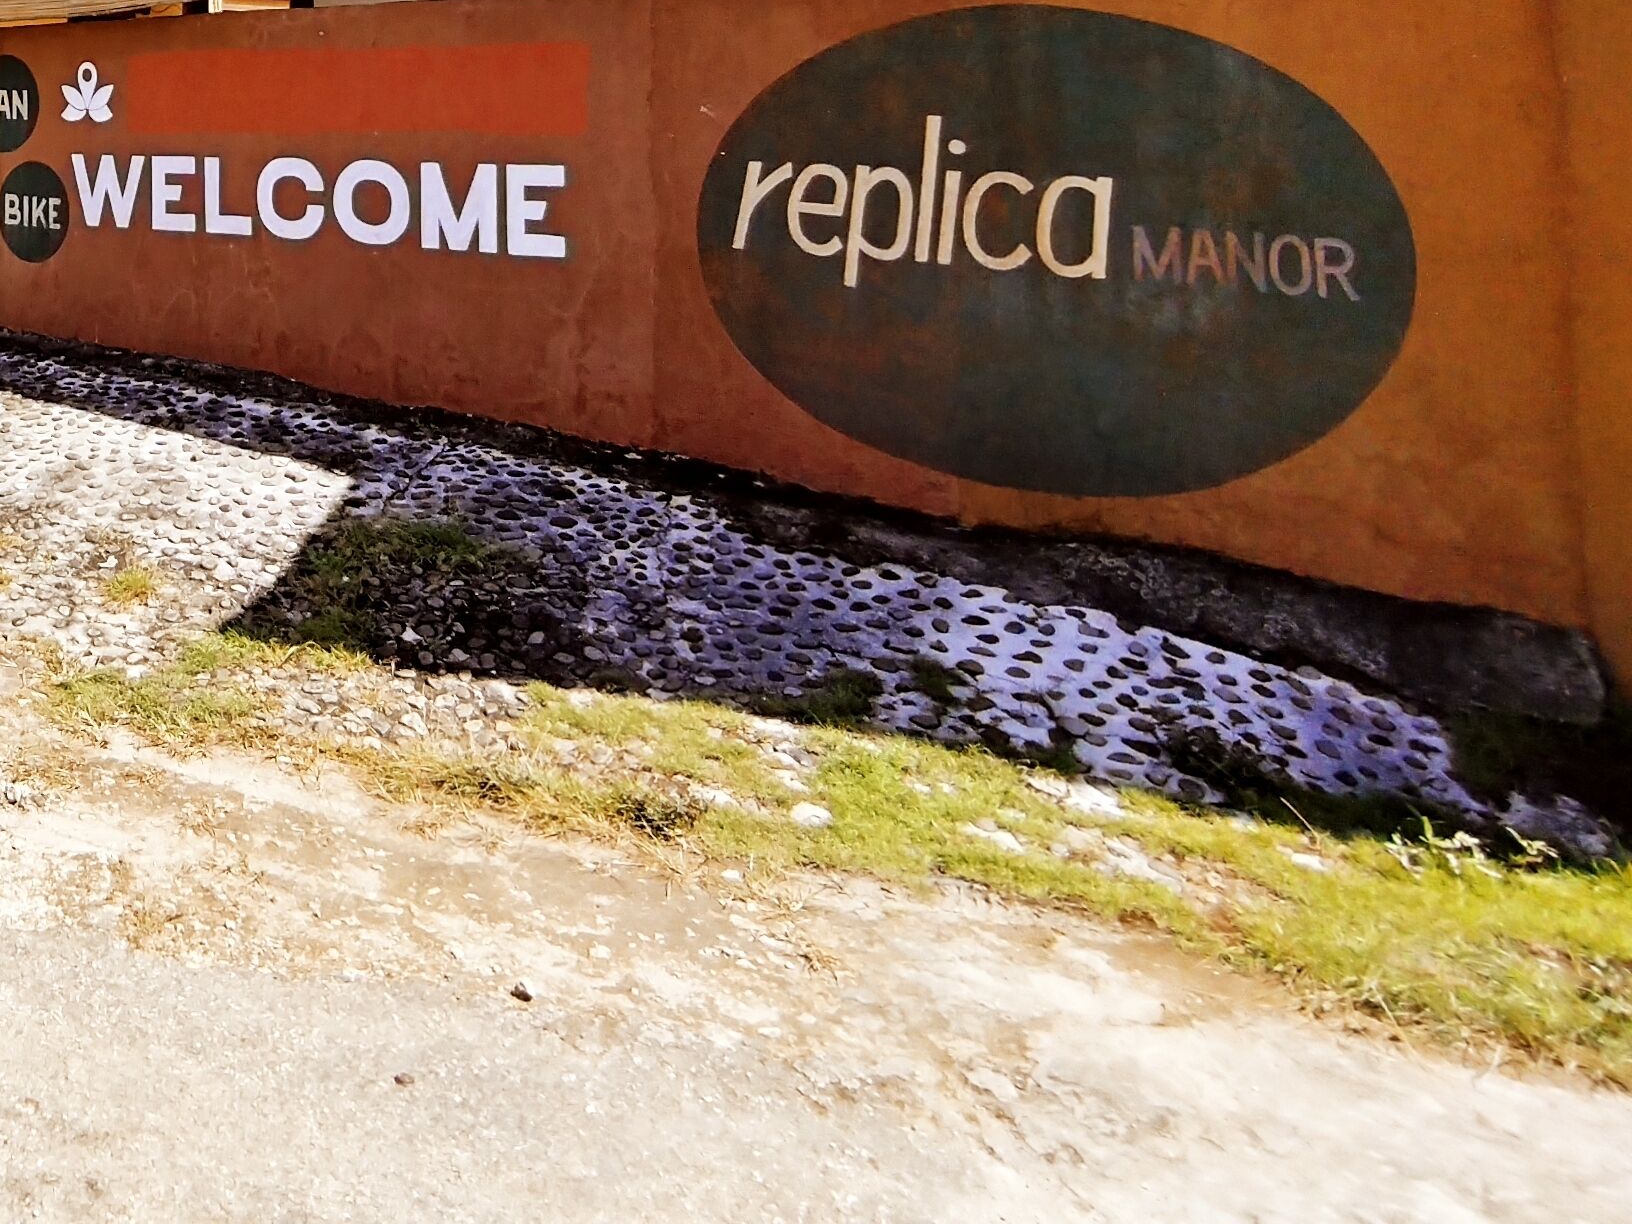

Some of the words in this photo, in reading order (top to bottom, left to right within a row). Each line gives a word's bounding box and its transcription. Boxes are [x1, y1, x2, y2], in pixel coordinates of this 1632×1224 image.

[3, 192, 62, 231] BIKE
[71, 153, 567, 258] WELCOME
[732, 115, 1114, 288] replica
[1131, 225, 1361, 302] MANOR
